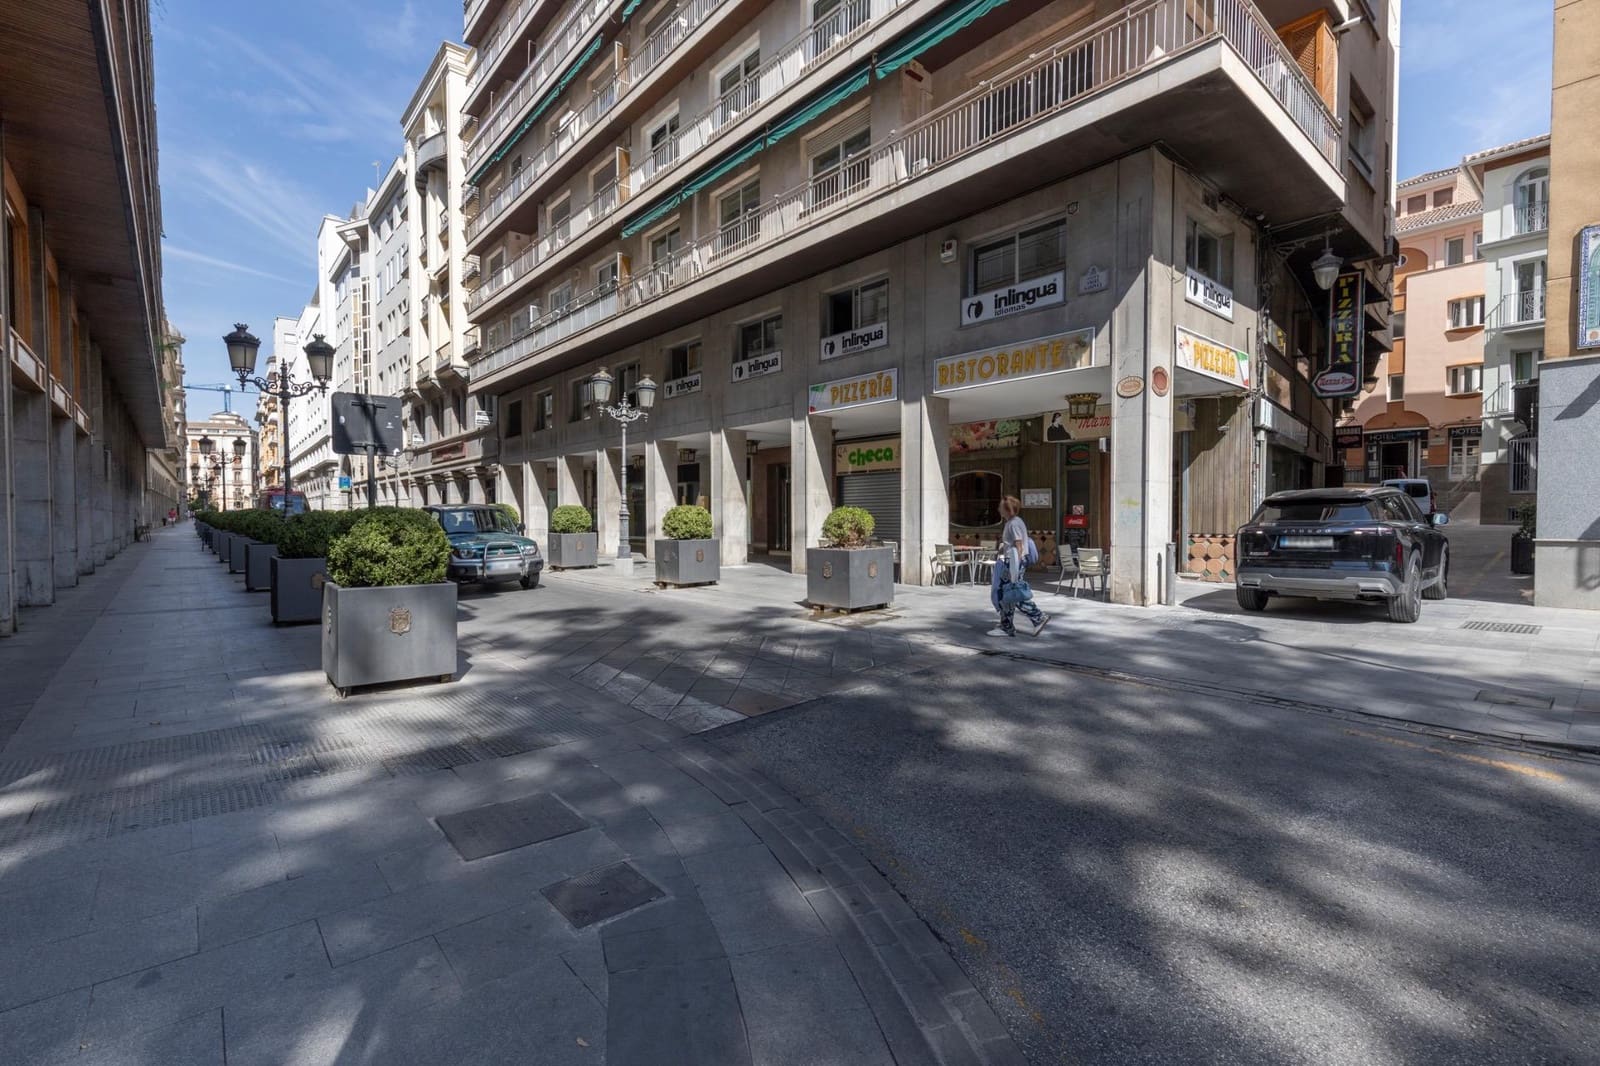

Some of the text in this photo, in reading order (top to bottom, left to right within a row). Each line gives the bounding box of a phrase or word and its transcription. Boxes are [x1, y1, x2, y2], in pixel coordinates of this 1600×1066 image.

[994, 282, 1057, 310] inlingua
[994, 303, 1026, 317] idiomas
[842, 329, 884, 349] inlingua
[748, 357, 779, 373] inlingua
[938, 340, 1065, 387] RISTORANTE
